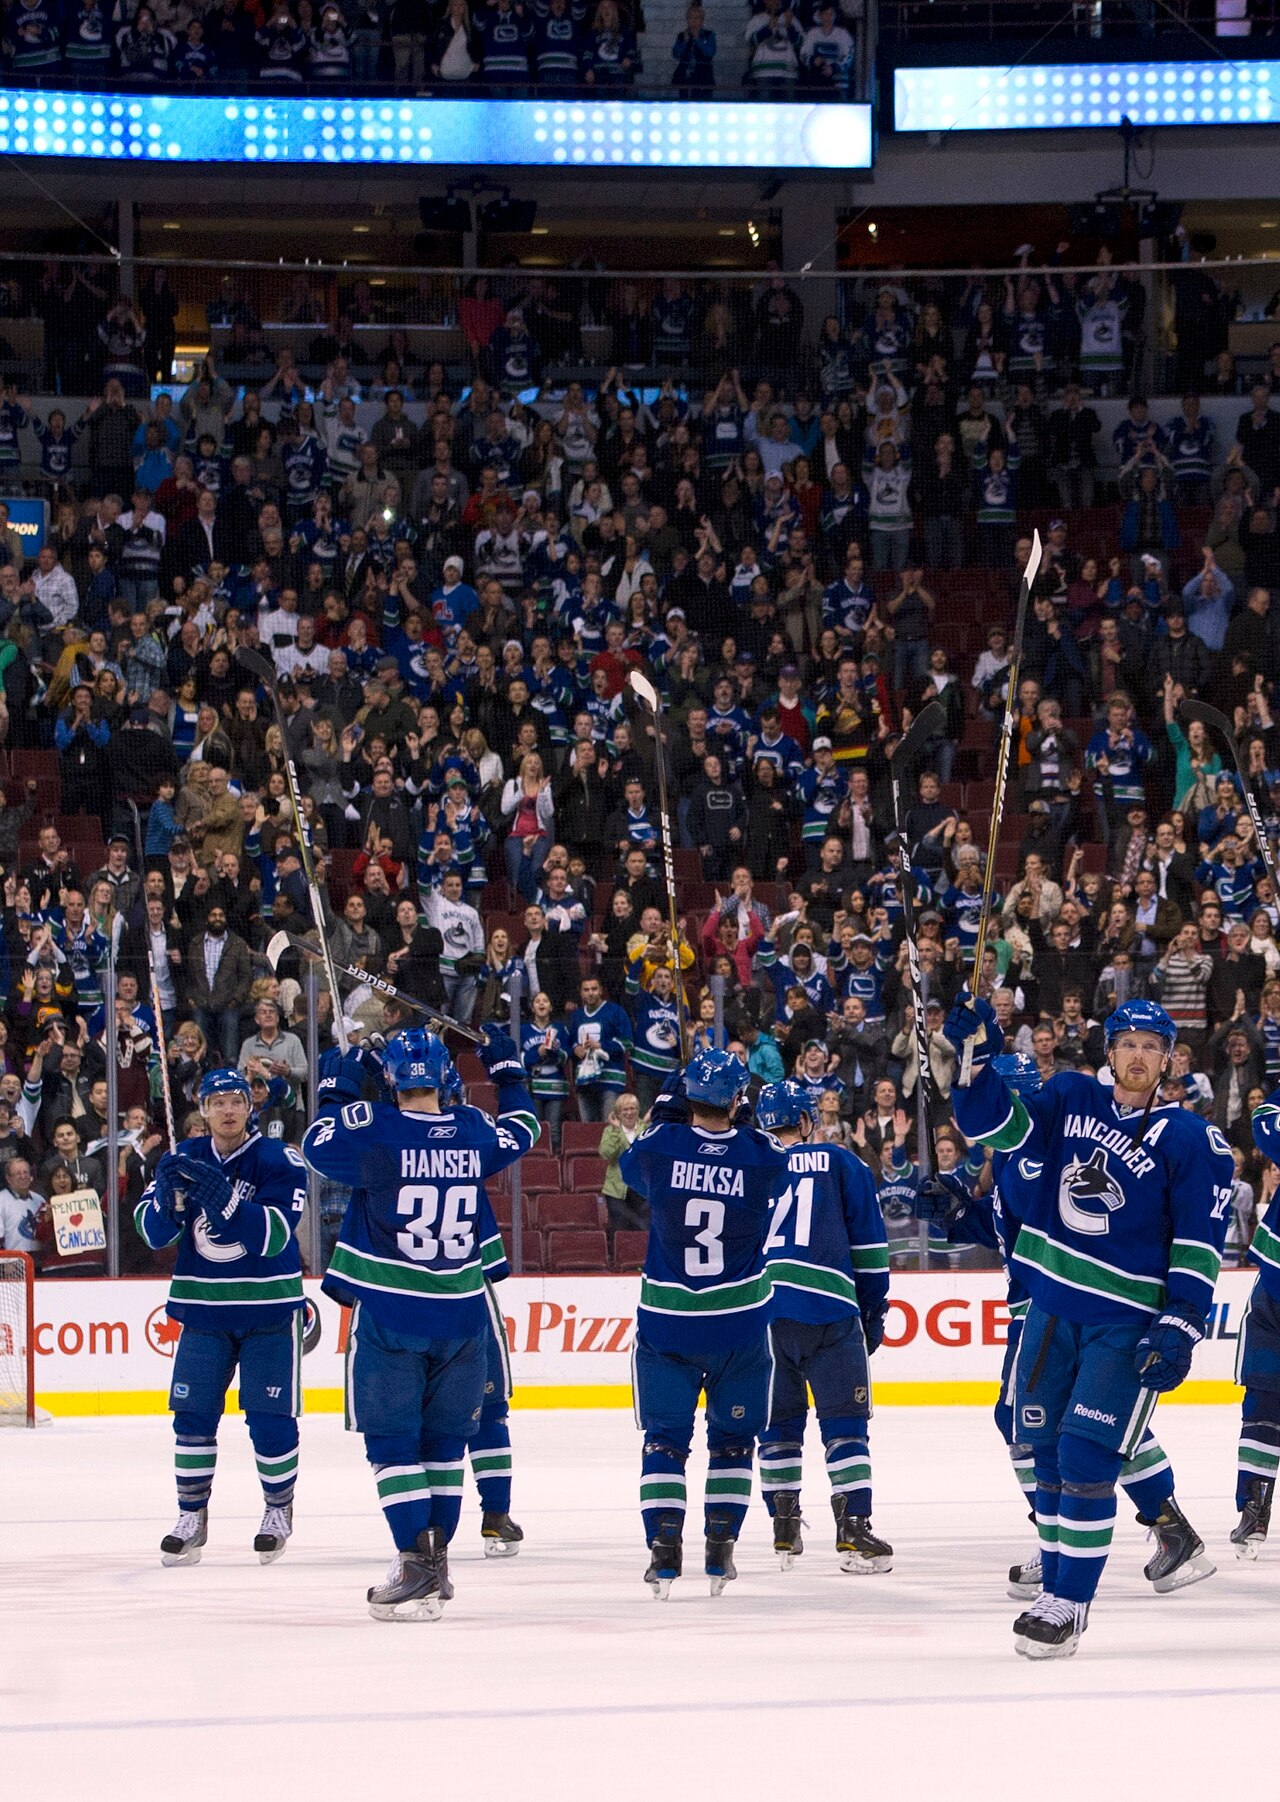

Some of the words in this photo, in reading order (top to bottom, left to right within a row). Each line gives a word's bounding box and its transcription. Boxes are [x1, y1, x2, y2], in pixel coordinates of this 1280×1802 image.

[348, 963, 397, 997] BAUER
[410, 1062, 426, 1076] 36
[765, 1112, 776, 1125] 21
[1142, 1118, 1169, 1147] A
[1063, 1114, 1156, 1179] VANCOUVER
[401, 1149, 481, 1179] HANSEN
[788, 1151, 830, 1174] OND
[670, 1160, 745, 1198] BIEKSA
[291, 1188, 306, 1212] 5
[396, 1184, 478, 1261] 36
[763, 1177, 815, 1256] 21
[684, 1197, 726, 1277] 3
[524, 1302, 634, 1354] Pizz
[1158, 1314, 1202, 1342] BAUER
[1073, 1402, 1119, 1427] Reebok
